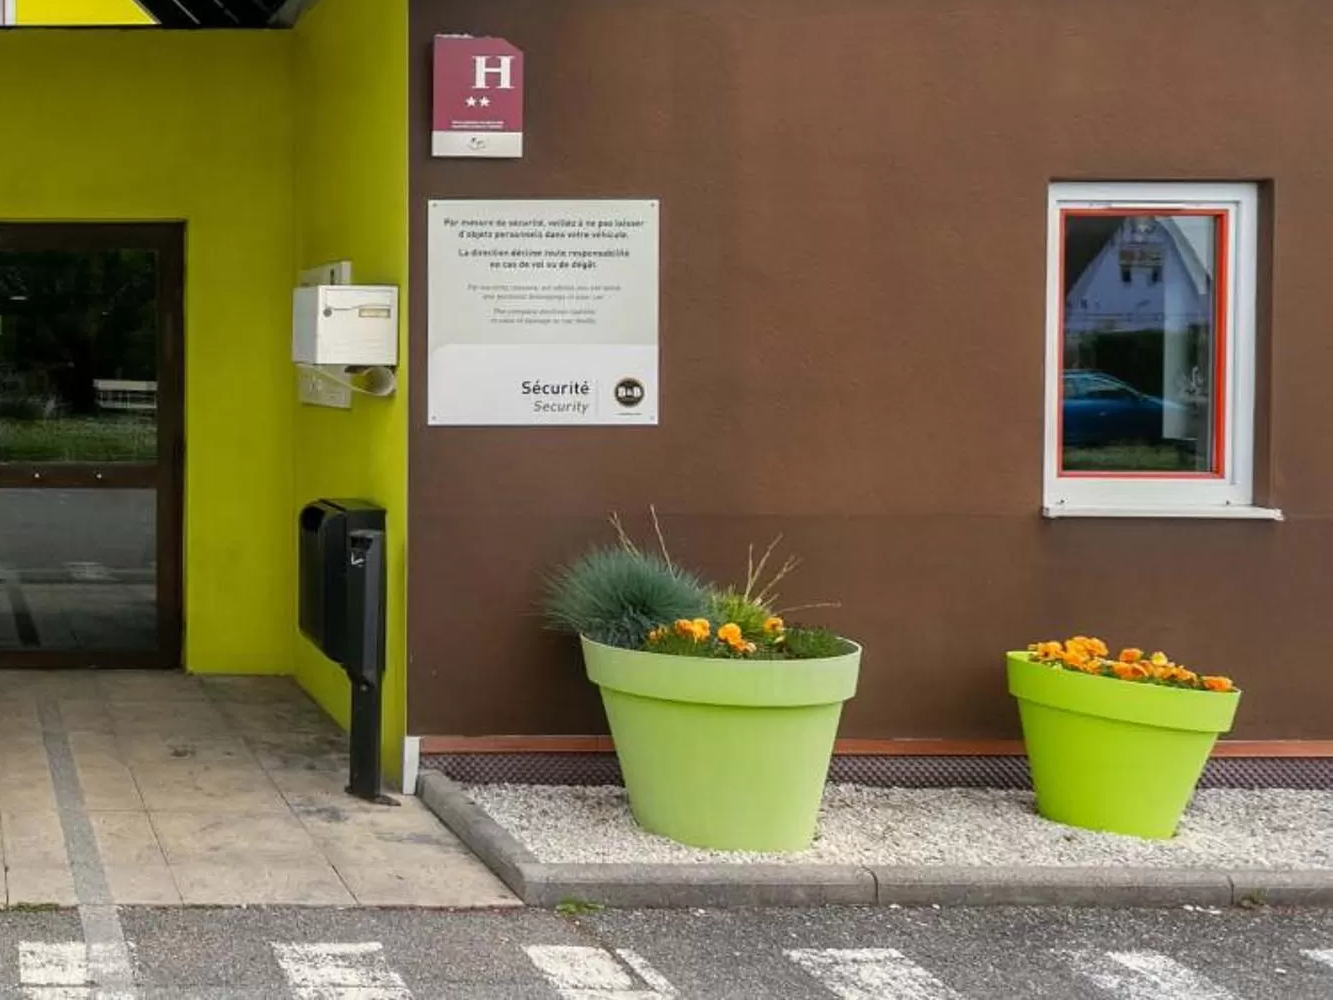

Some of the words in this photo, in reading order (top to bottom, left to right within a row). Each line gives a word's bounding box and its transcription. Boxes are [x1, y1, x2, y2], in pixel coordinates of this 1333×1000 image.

[471, 55, 516, 90] H
[443, 217, 458, 227] Par
[496, 217, 507, 227] de
[597, 219, 613, 229] pas
[614, 217, 644, 227] laisser
[545, 230, 565, 238] dans
[458, 248, 470, 257] La
[518, 260, 530, 268] de
[531, 260, 545, 268] vol
[558, 260, 570, 268] de
[521, 379, 590, 395] Sécurité
[533, 400, 590, 415] Security
